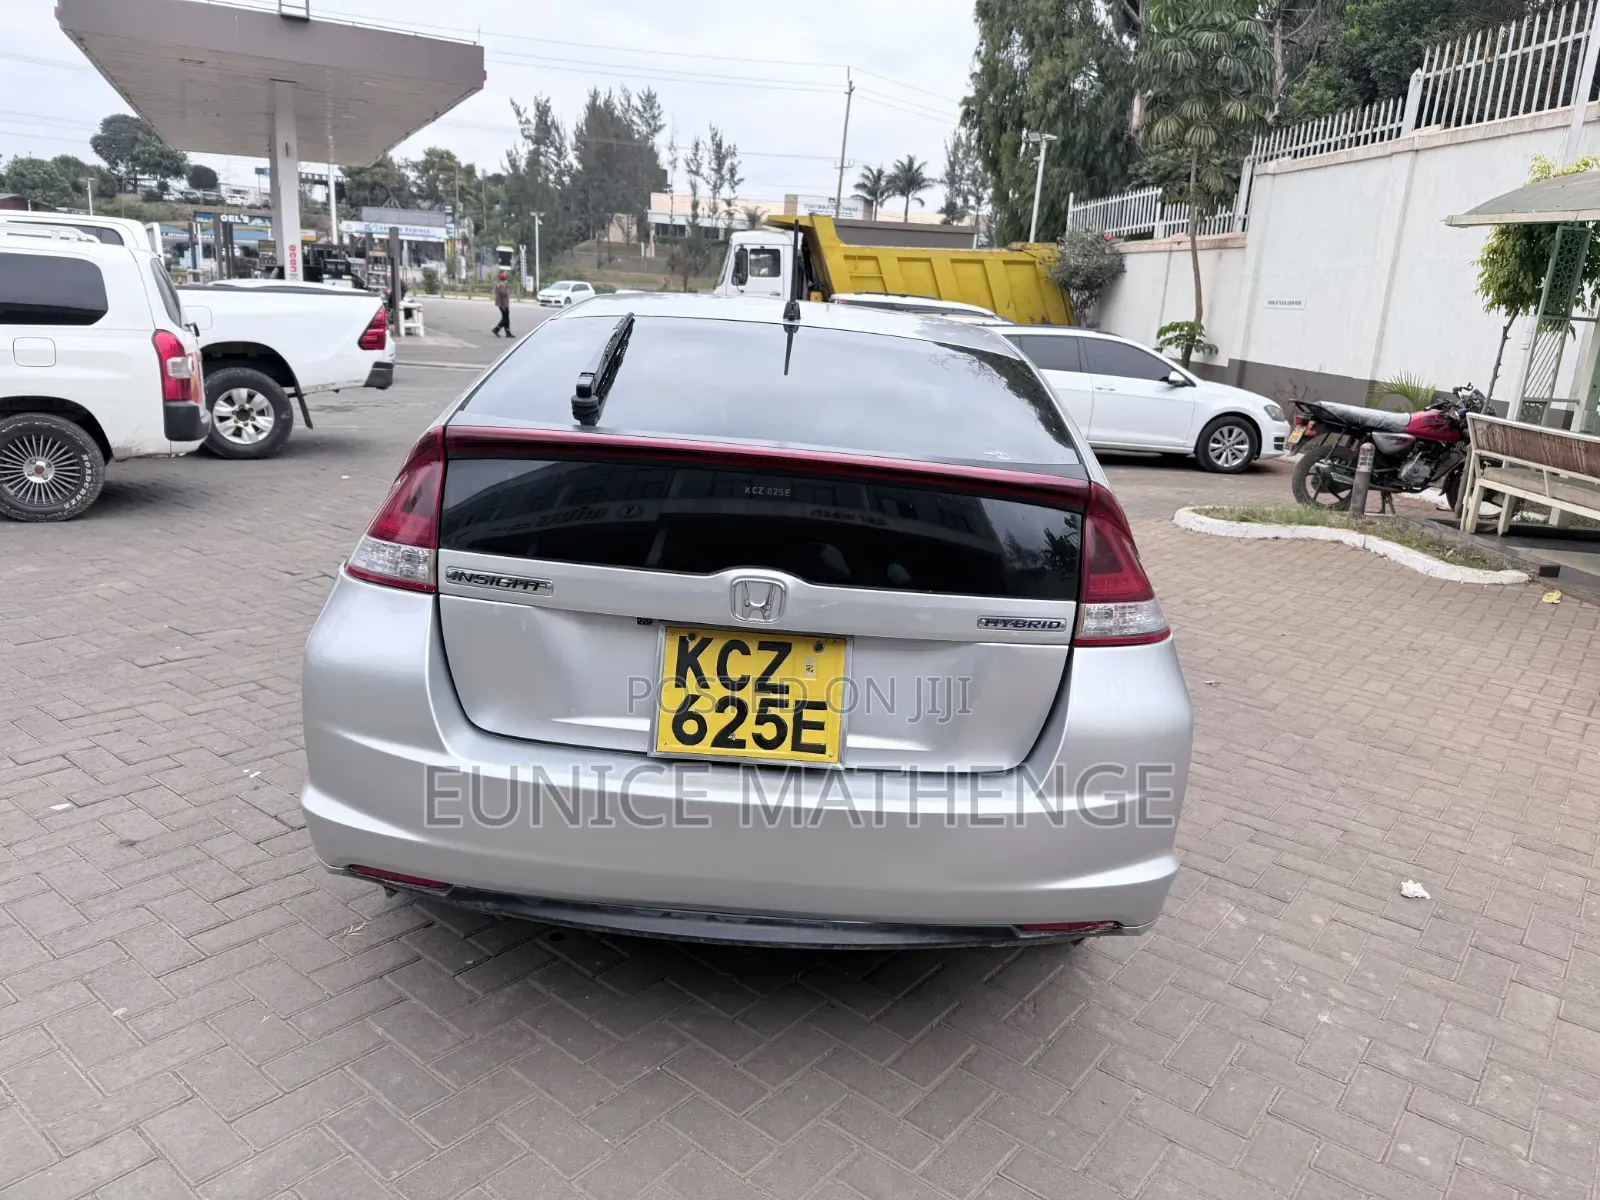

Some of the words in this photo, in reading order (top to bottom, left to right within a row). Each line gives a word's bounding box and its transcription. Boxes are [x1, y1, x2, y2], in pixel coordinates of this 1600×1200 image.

[744, 486, 764, 495] KCZ
[450, 571, 547, 592] INSIGHT
[983, 618, 1063, 629] HYBRID
[674, 635, 793, 695] KCZ
[671, 693, 828, 754] 625E
